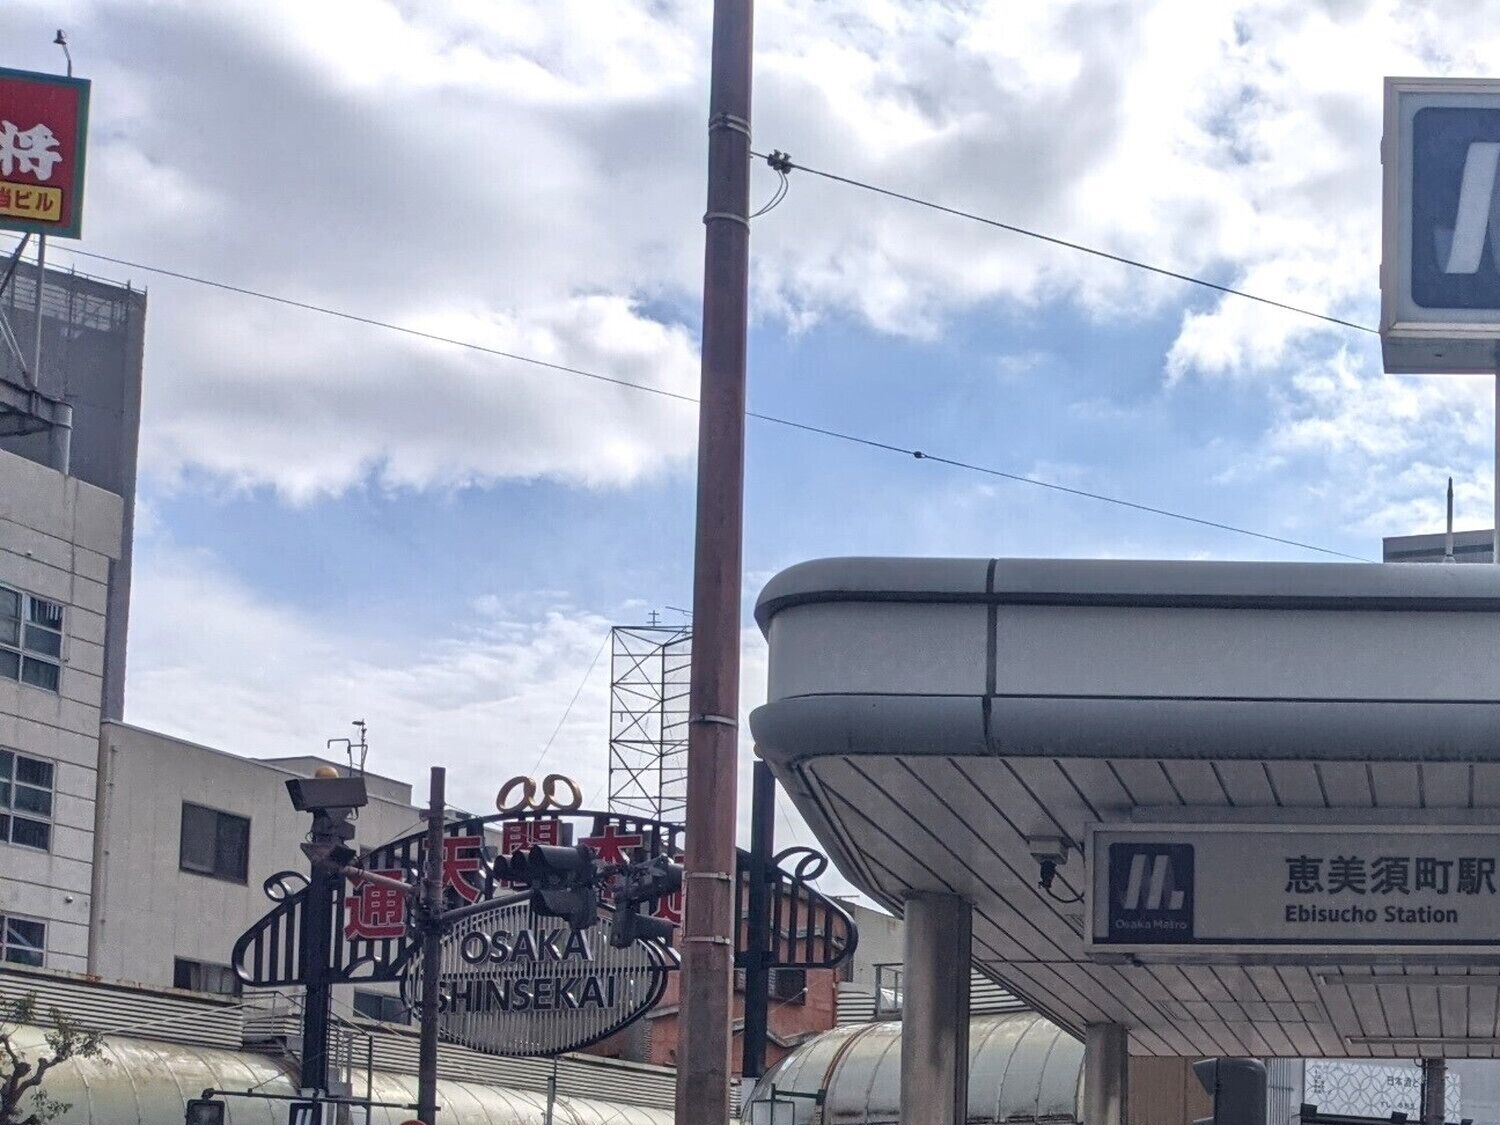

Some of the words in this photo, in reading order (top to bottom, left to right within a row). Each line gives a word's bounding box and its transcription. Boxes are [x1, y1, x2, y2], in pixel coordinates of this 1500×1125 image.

[1285, 856, 1496, 895] 恵美須町駅
[1115, 918, 1151, 930] Osaka
[1285, 905, 1377, 923] Ebisucho
[1384, 905, 1458, 923] Station
[461, 929, 593, 964] OSAKA
